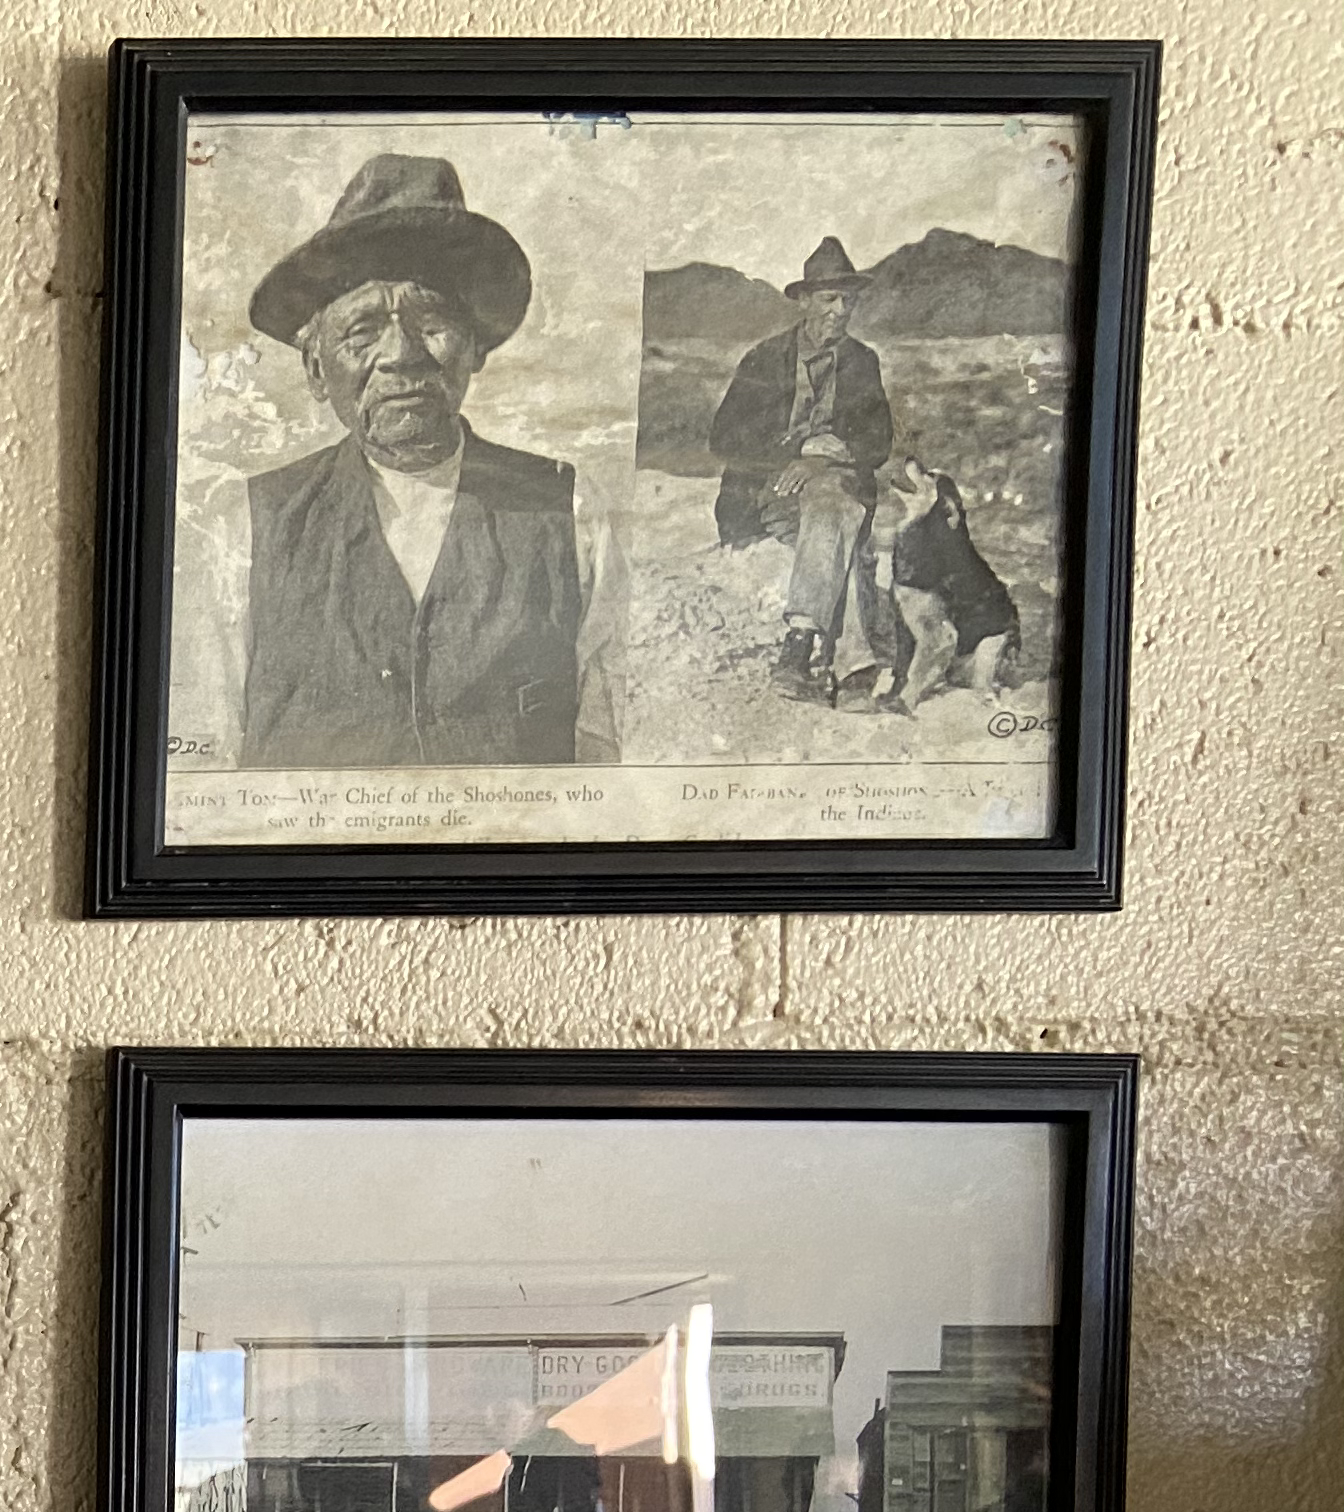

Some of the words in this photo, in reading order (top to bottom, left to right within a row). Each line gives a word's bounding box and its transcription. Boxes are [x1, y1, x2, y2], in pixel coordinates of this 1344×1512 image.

[346, 787, 394, 804] Chief
[401, 787, 418, 804] of
[428, 786, 454, 803] the
[464, 786, 557, 804] Shoshones,
[566, 785, 604, 802] who
[345, 811, 430, 830] emigrants
[440, 809, 473, 826] die.
[820, 804, 847, 821] the
[542, 1355, 584, 1374] DRY
